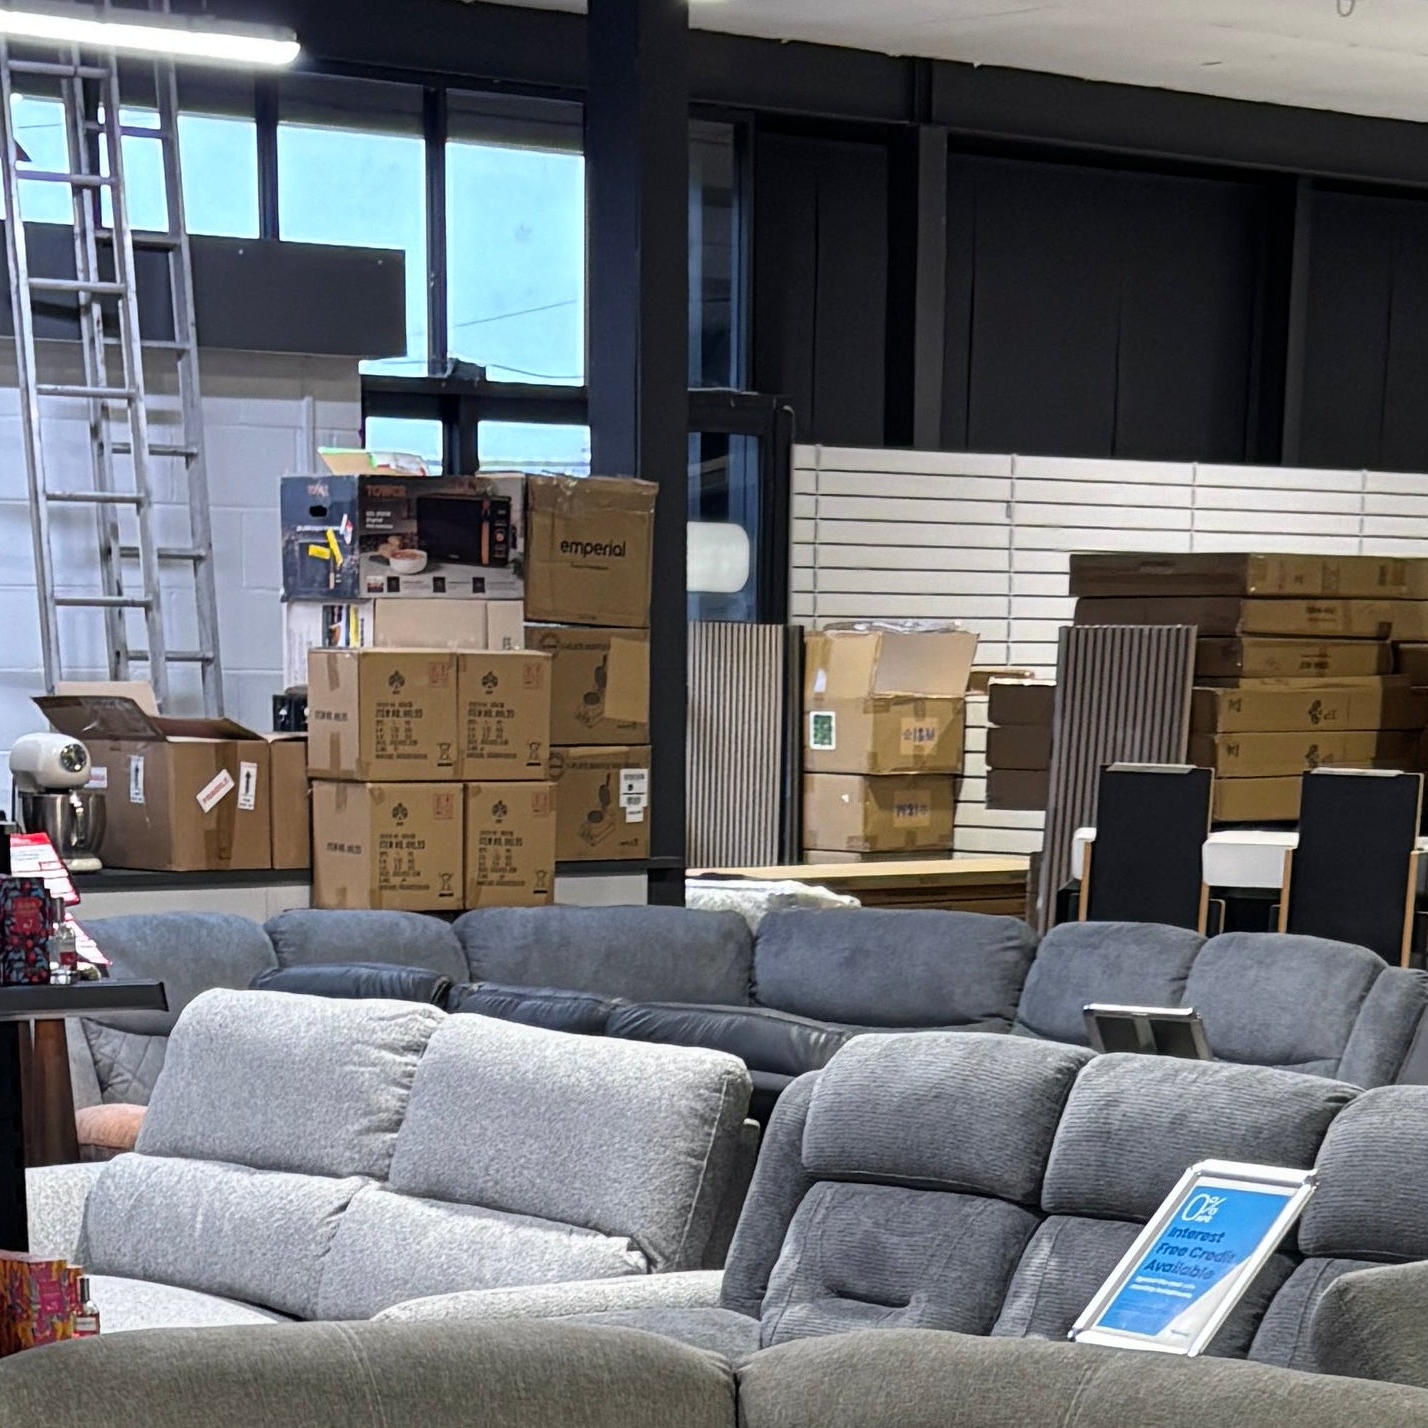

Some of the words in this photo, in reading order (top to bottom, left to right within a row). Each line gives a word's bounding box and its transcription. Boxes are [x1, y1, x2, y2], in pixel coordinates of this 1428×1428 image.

[559, 539, 627, 557] emperial
[1181, 1193, 1227, 1222] 0%
[1167, 1227, 1226, 1243] Interest
[1155, 1243, 1189, 1257] Free
[1188, 1248, 1236, 1264] Credit
[1144, 1259, 1215, 1280] Available
